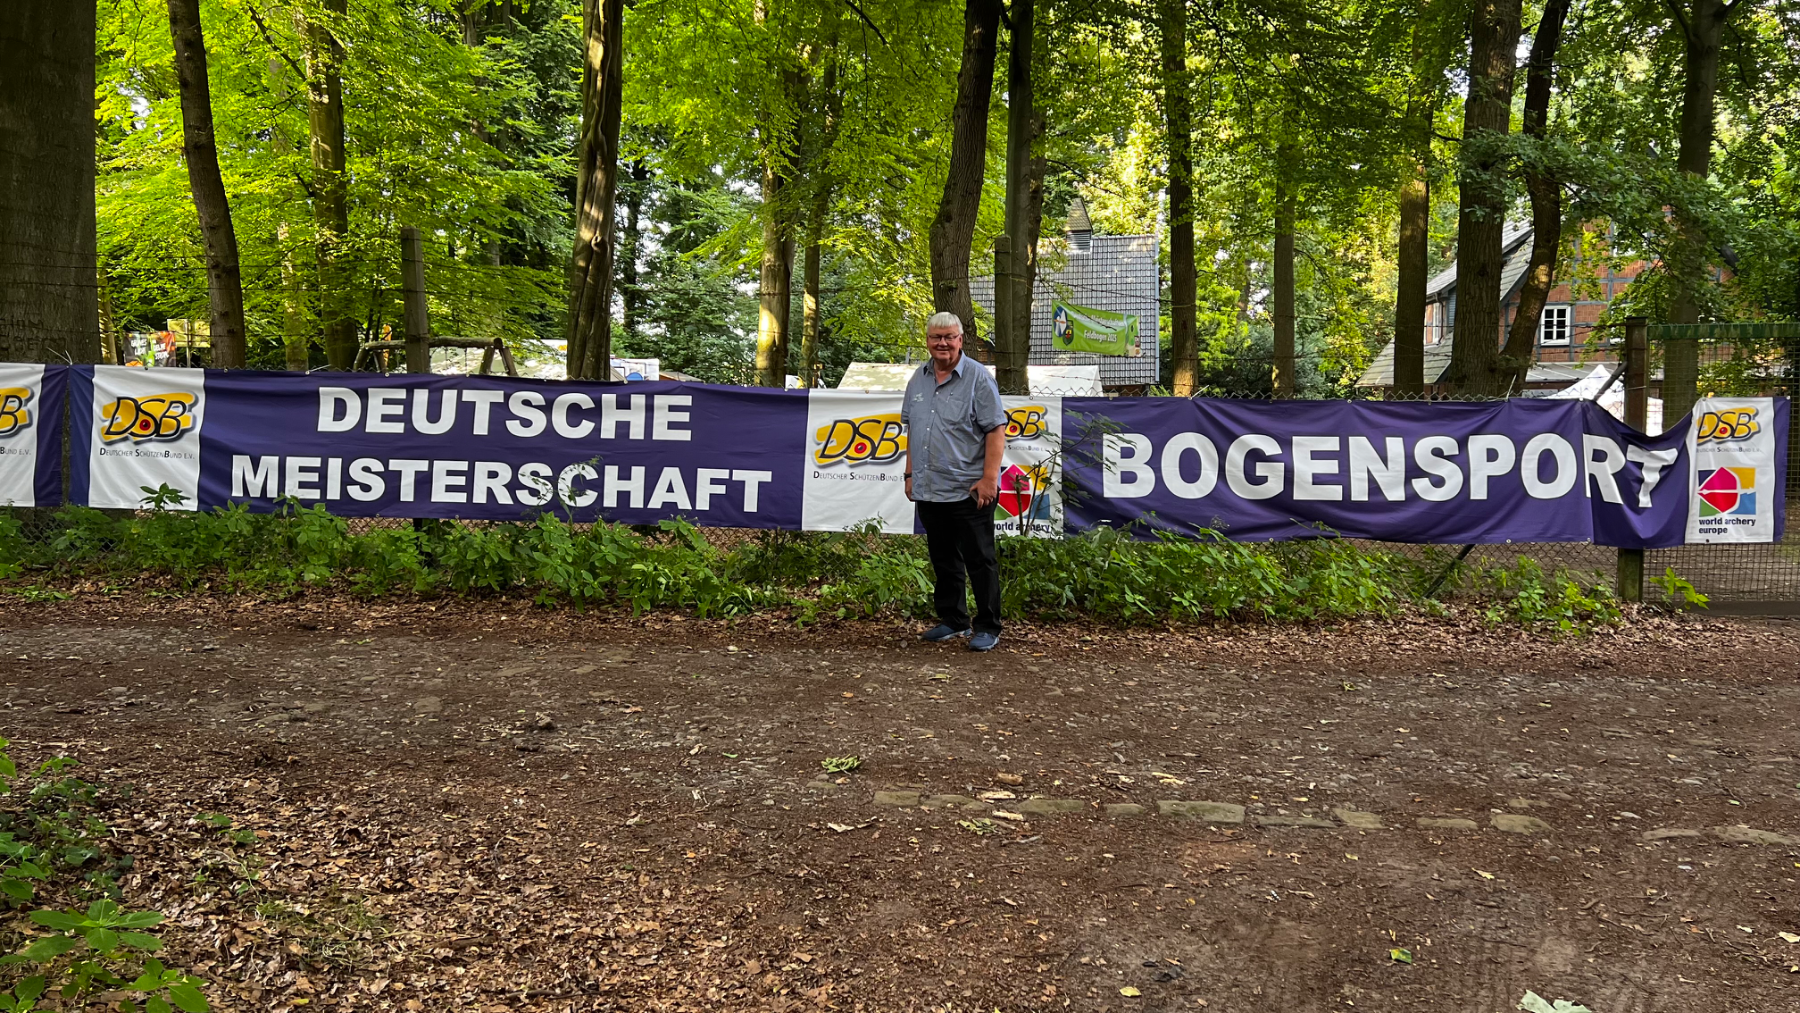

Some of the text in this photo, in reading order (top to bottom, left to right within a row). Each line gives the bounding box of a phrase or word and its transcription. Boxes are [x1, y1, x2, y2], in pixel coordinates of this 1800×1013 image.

[105, 396, 189, 439] DSB
[317, 386, 693, 442] DEUTSCHE
[1004, 409, 1041, 438] SB
[1697, 411, 1752, 439] DSB
[819, 419, 903, 461] DSB
[230, 455, 773, 513] MEISTERSCHAFT
[813, 470, 848, 480] DEUTSCHER
[1102, 432, 1679, 508] BOGENSPORT
[1698, 517, 1756, 527] world archery
[1698, 526, 1728, 535] europe
